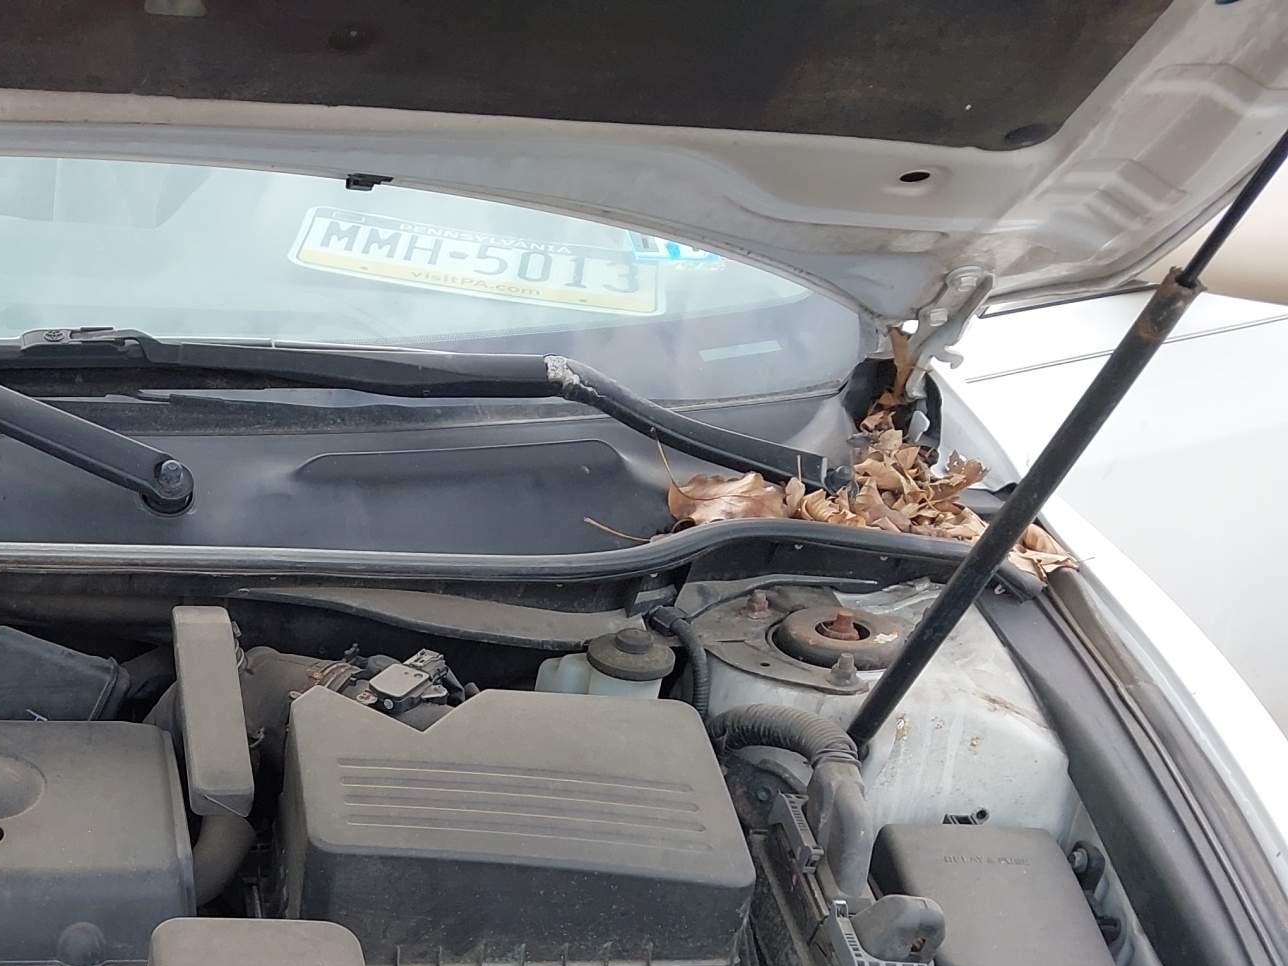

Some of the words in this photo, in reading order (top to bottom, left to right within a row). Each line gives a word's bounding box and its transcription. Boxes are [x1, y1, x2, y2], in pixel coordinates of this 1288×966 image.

[398, 222, 574, 255] PENNSYLVANIA
[319, 219, 640, 295] MMH-5013
[410, 270, 543, 297] visitPA.com
